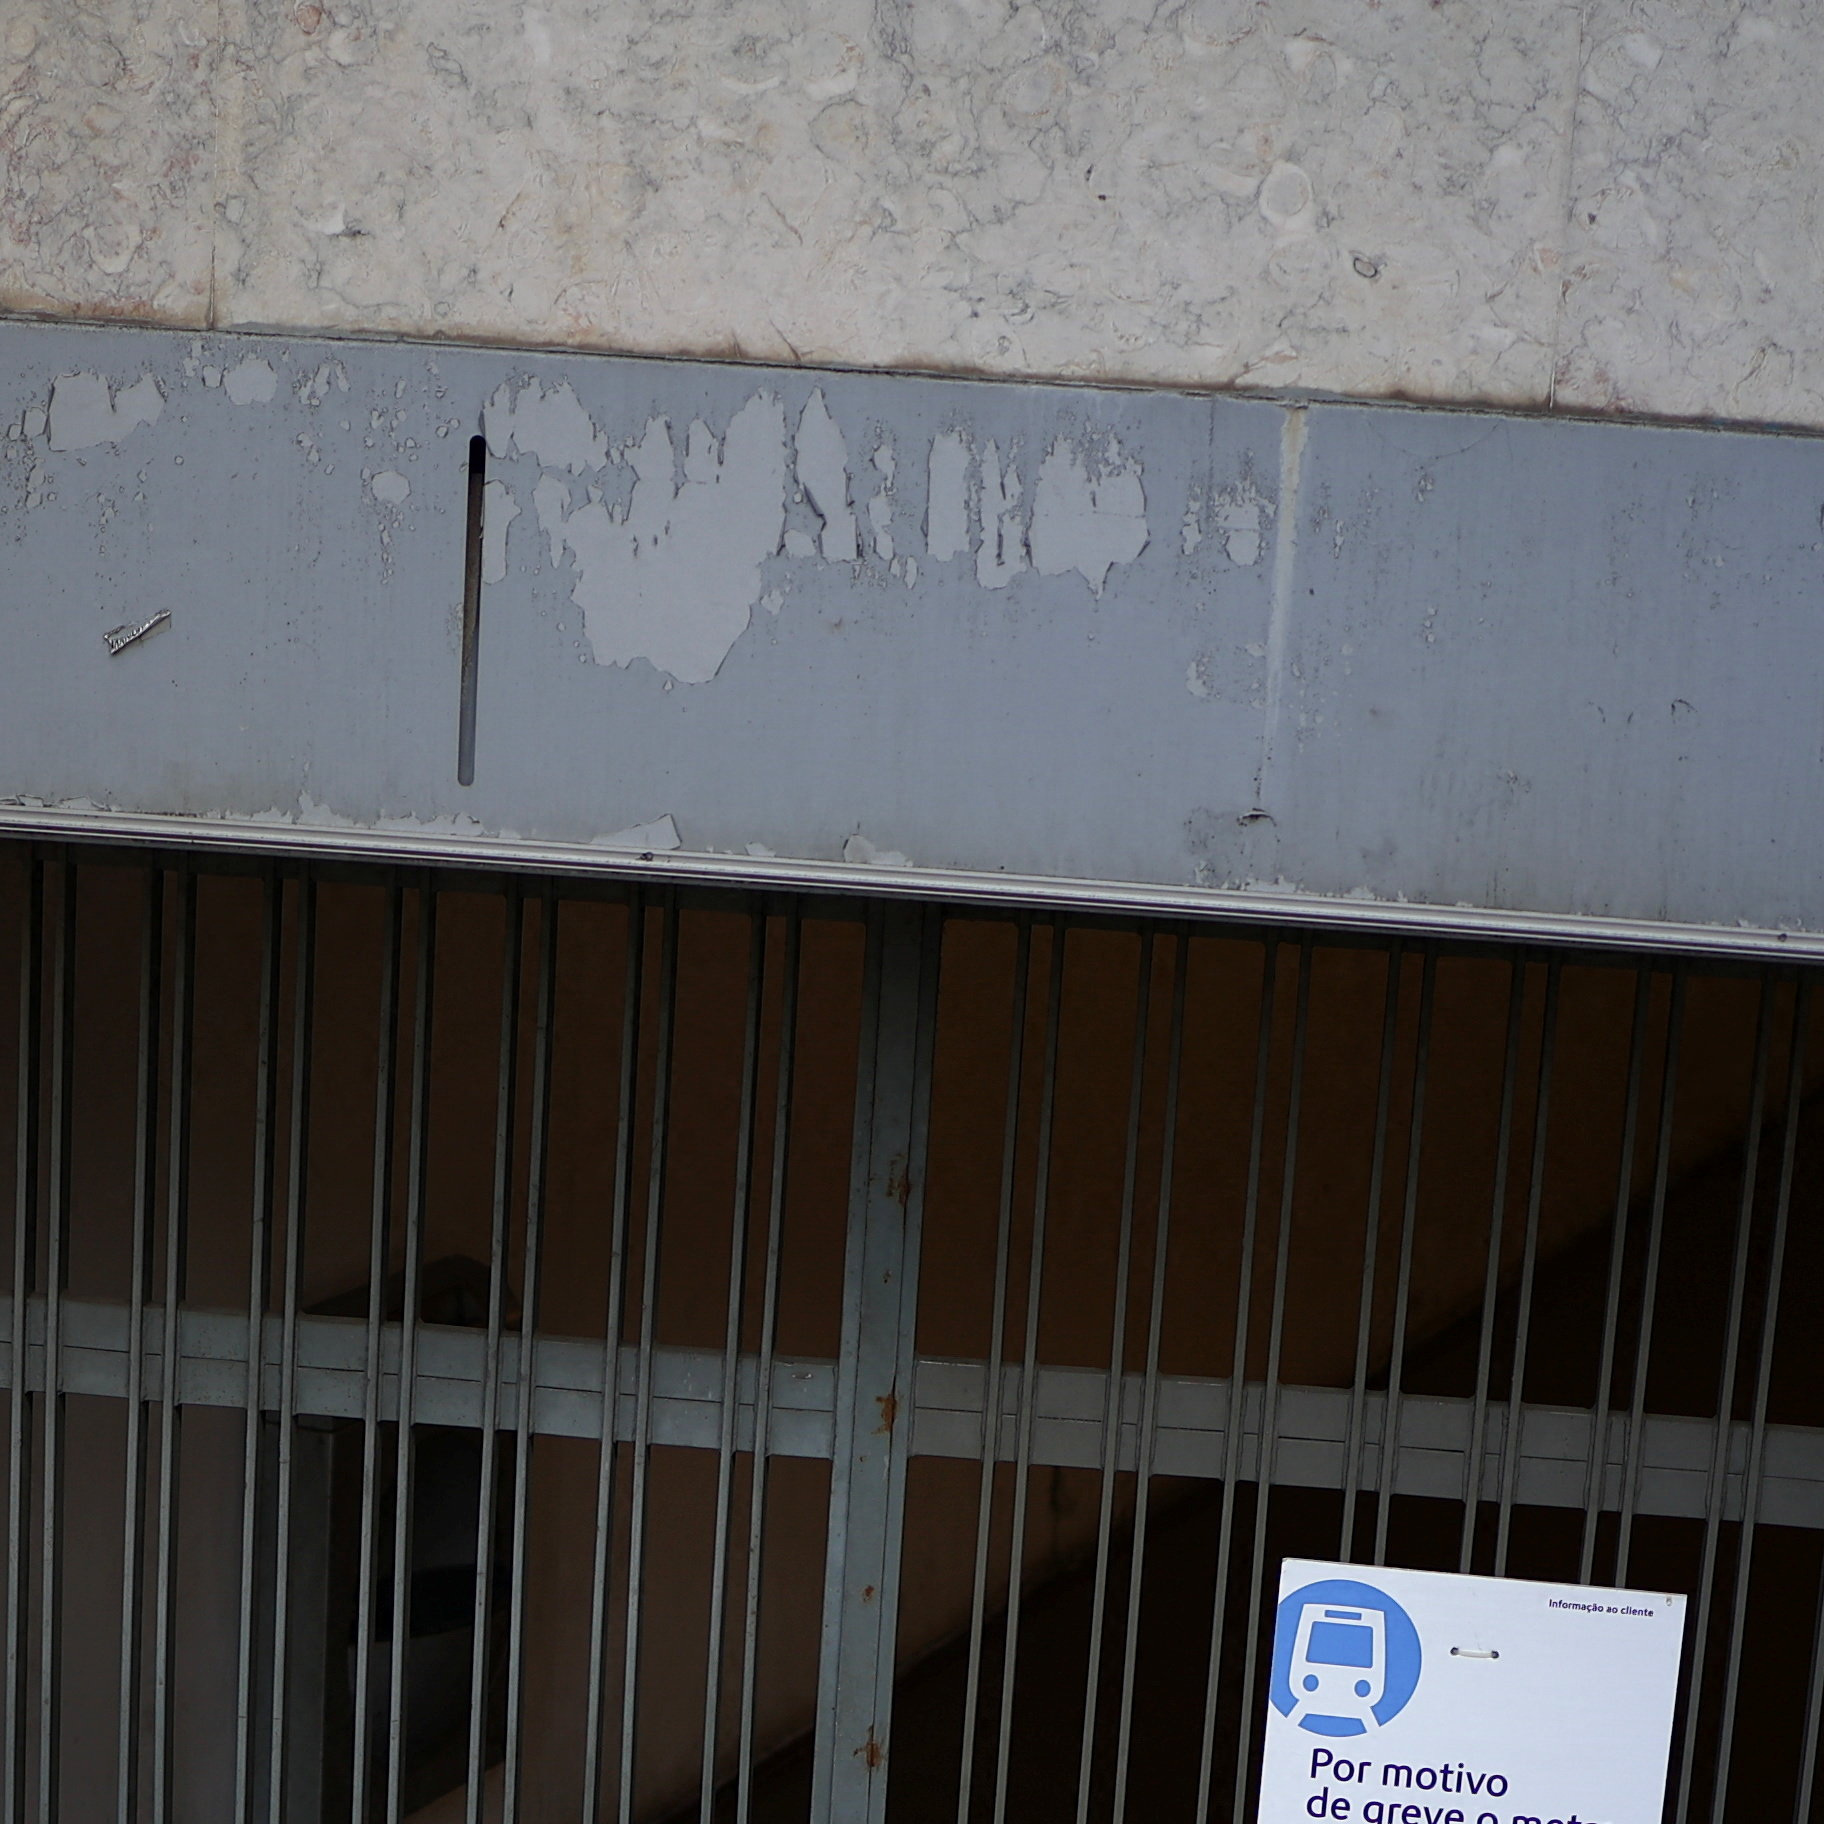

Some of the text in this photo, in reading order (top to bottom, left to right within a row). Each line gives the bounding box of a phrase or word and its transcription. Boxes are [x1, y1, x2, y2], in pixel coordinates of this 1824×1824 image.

[1549, 1599, 1654, 1617] Informação ao cliente
[1310, 1748, 1508, 1797] Por motivo
[1306, 1786, 1351, 1820] de
